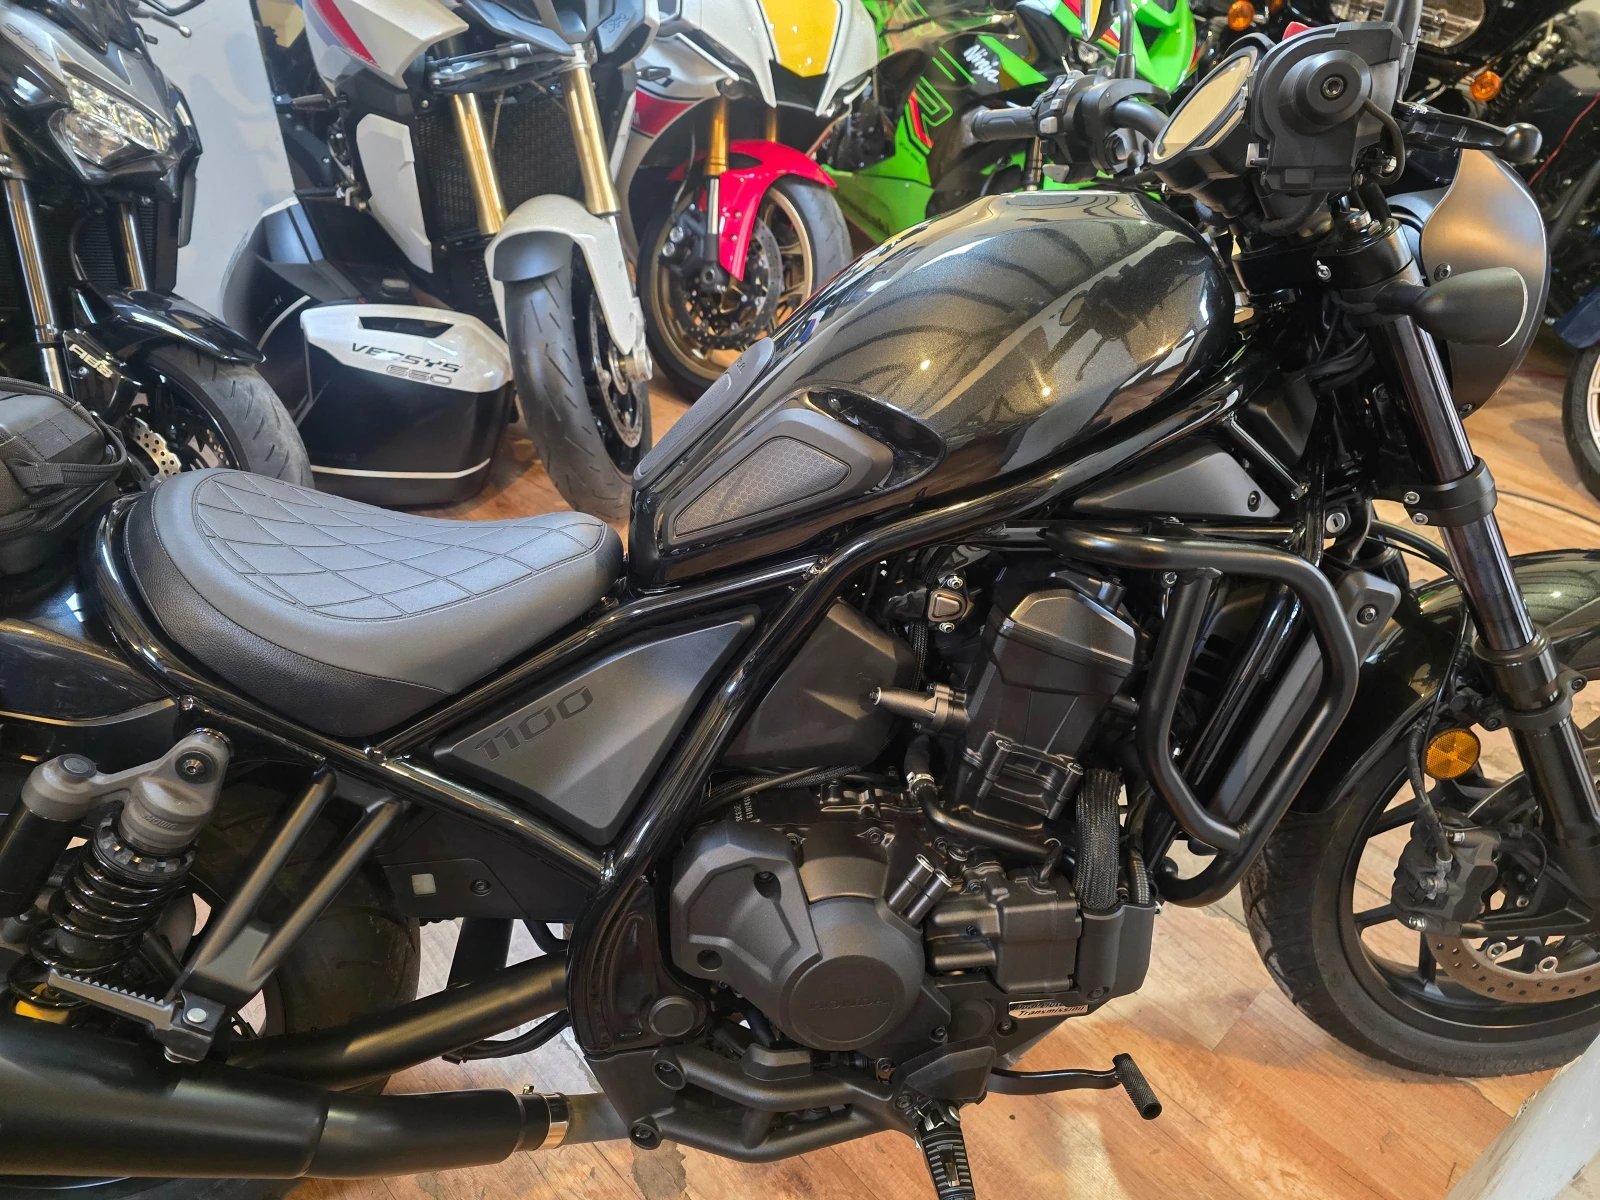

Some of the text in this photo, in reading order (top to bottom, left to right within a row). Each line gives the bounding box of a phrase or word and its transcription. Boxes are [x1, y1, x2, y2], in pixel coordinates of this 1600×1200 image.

[963, 43, 1000, 84] Ninja
[68, 343, 113, 378] ABS
[386, 364, 453, 386] 650
[474, 685, 594, 761] 1100
